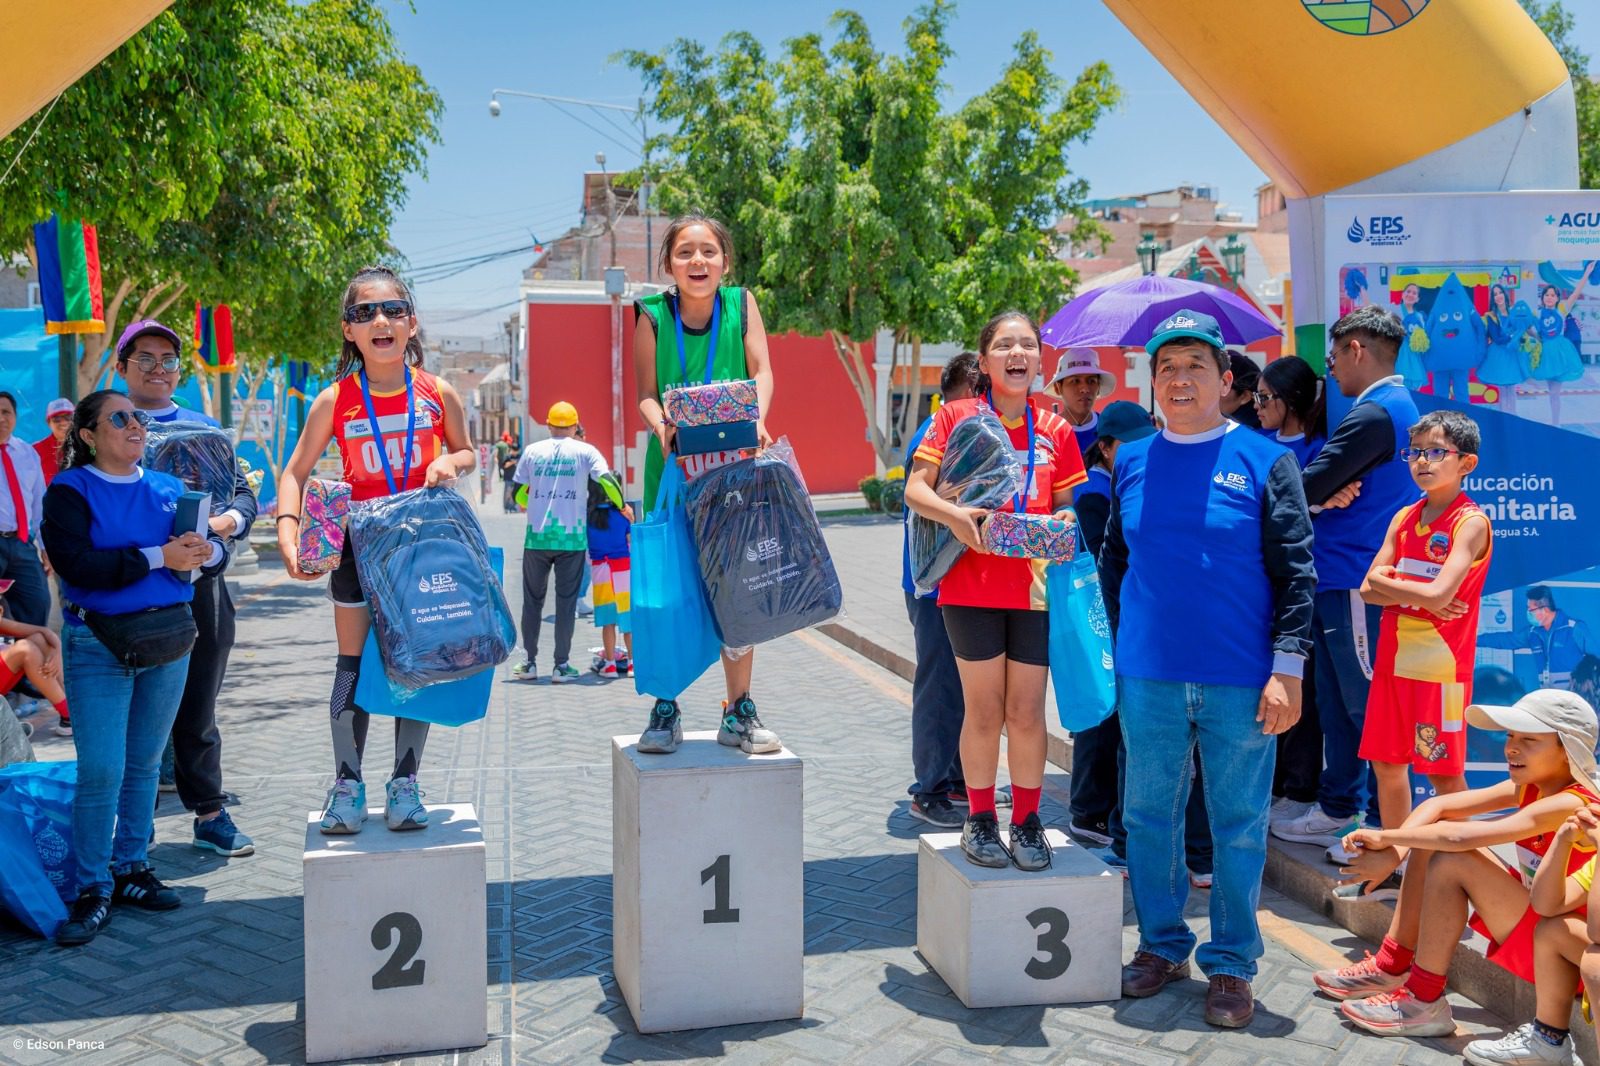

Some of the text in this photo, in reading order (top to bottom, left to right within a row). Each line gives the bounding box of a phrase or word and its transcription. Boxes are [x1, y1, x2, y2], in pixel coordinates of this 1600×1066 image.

[1370, 216, 1404, 235] EPS
[1559, 212, 1600, 228] AGU
[361, 435, 422, 474] 045
[1460, 473, 1554, 491] ducación
[1479, 496, 1577, 521] nitaria
[1523, 527, 1540, 536] S.A.
[757, 537, 778, 553] EPS
[431, 572, 453, 584] EPS
[701, 855, 740, 924] 1
[371, 911, 426, 991] 2
[1023, 907, 1072, 981] 3
